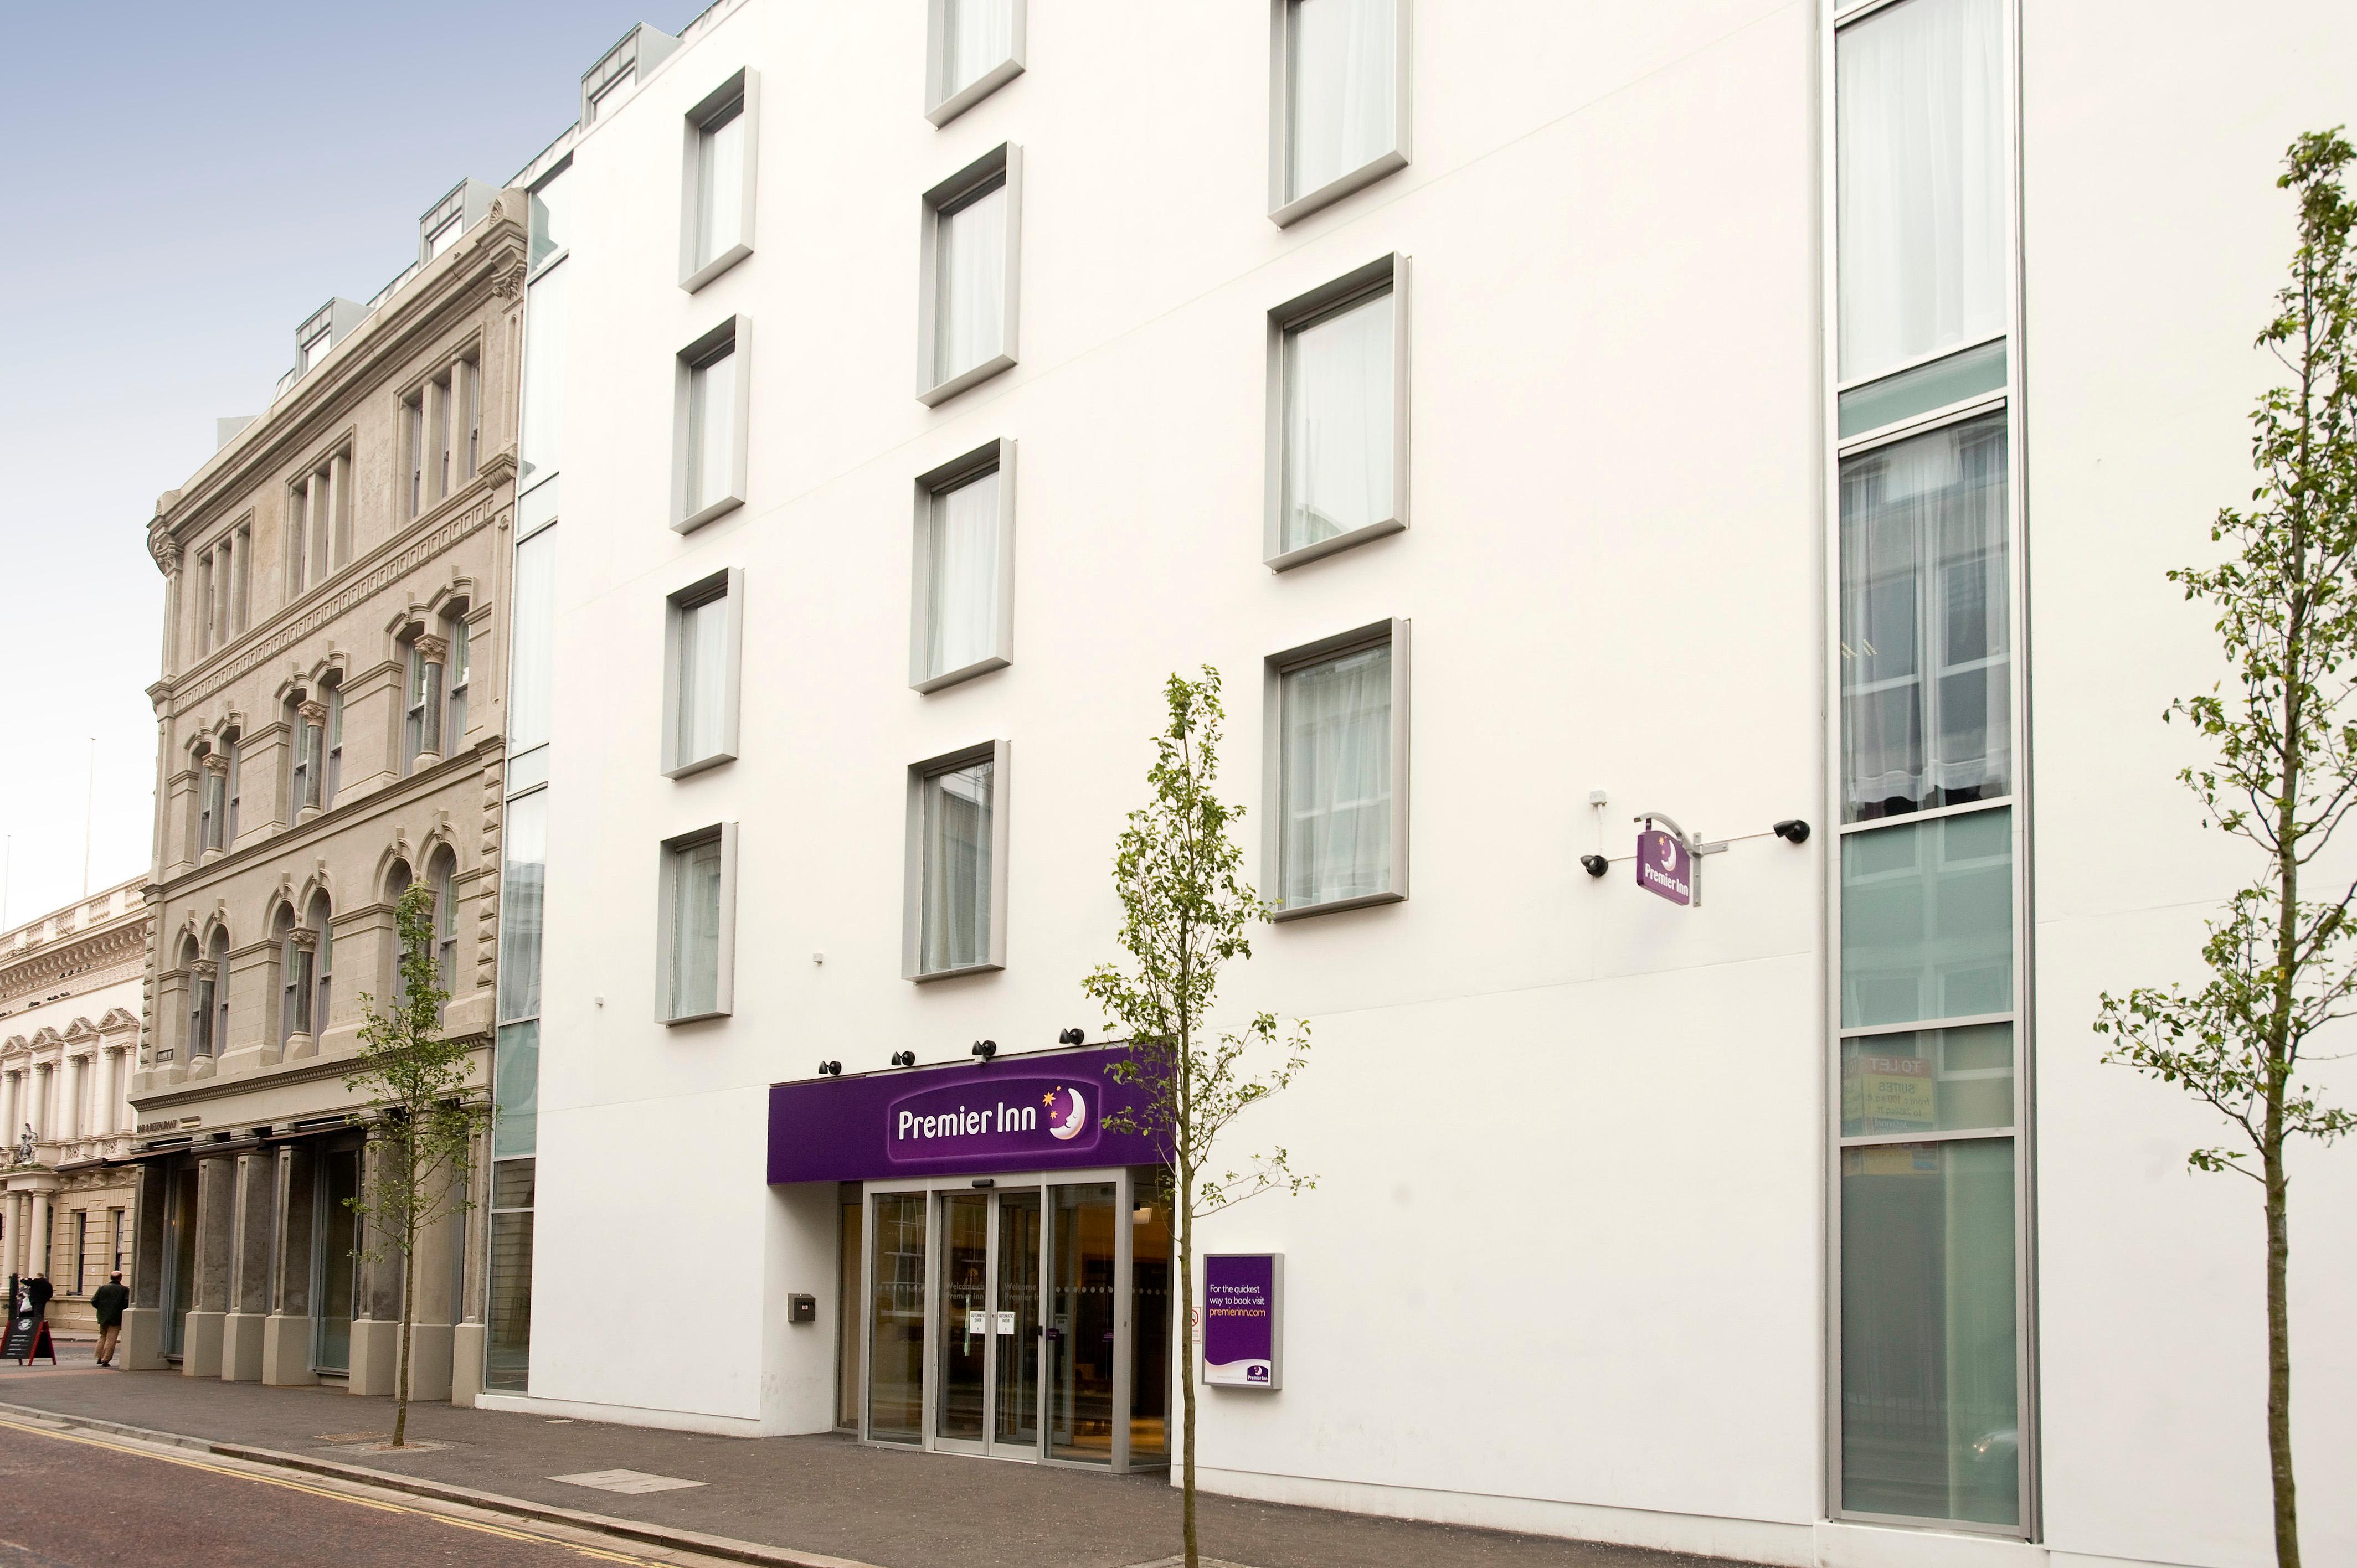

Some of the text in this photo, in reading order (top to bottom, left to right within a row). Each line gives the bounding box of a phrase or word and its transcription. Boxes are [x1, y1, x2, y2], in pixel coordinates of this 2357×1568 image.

[1645, 863, 1689, 897] Premier Inn
[898, 1102, 1036, 1140] Premier Inn
[948, 1282, 977, 1290] Welcome
[1210, 1284, 1260, 1295] For the quickest
[1210, 1296, 1265, 1307] way to book visit
[1210, 1307, 1266, 1318] premierinn.com
